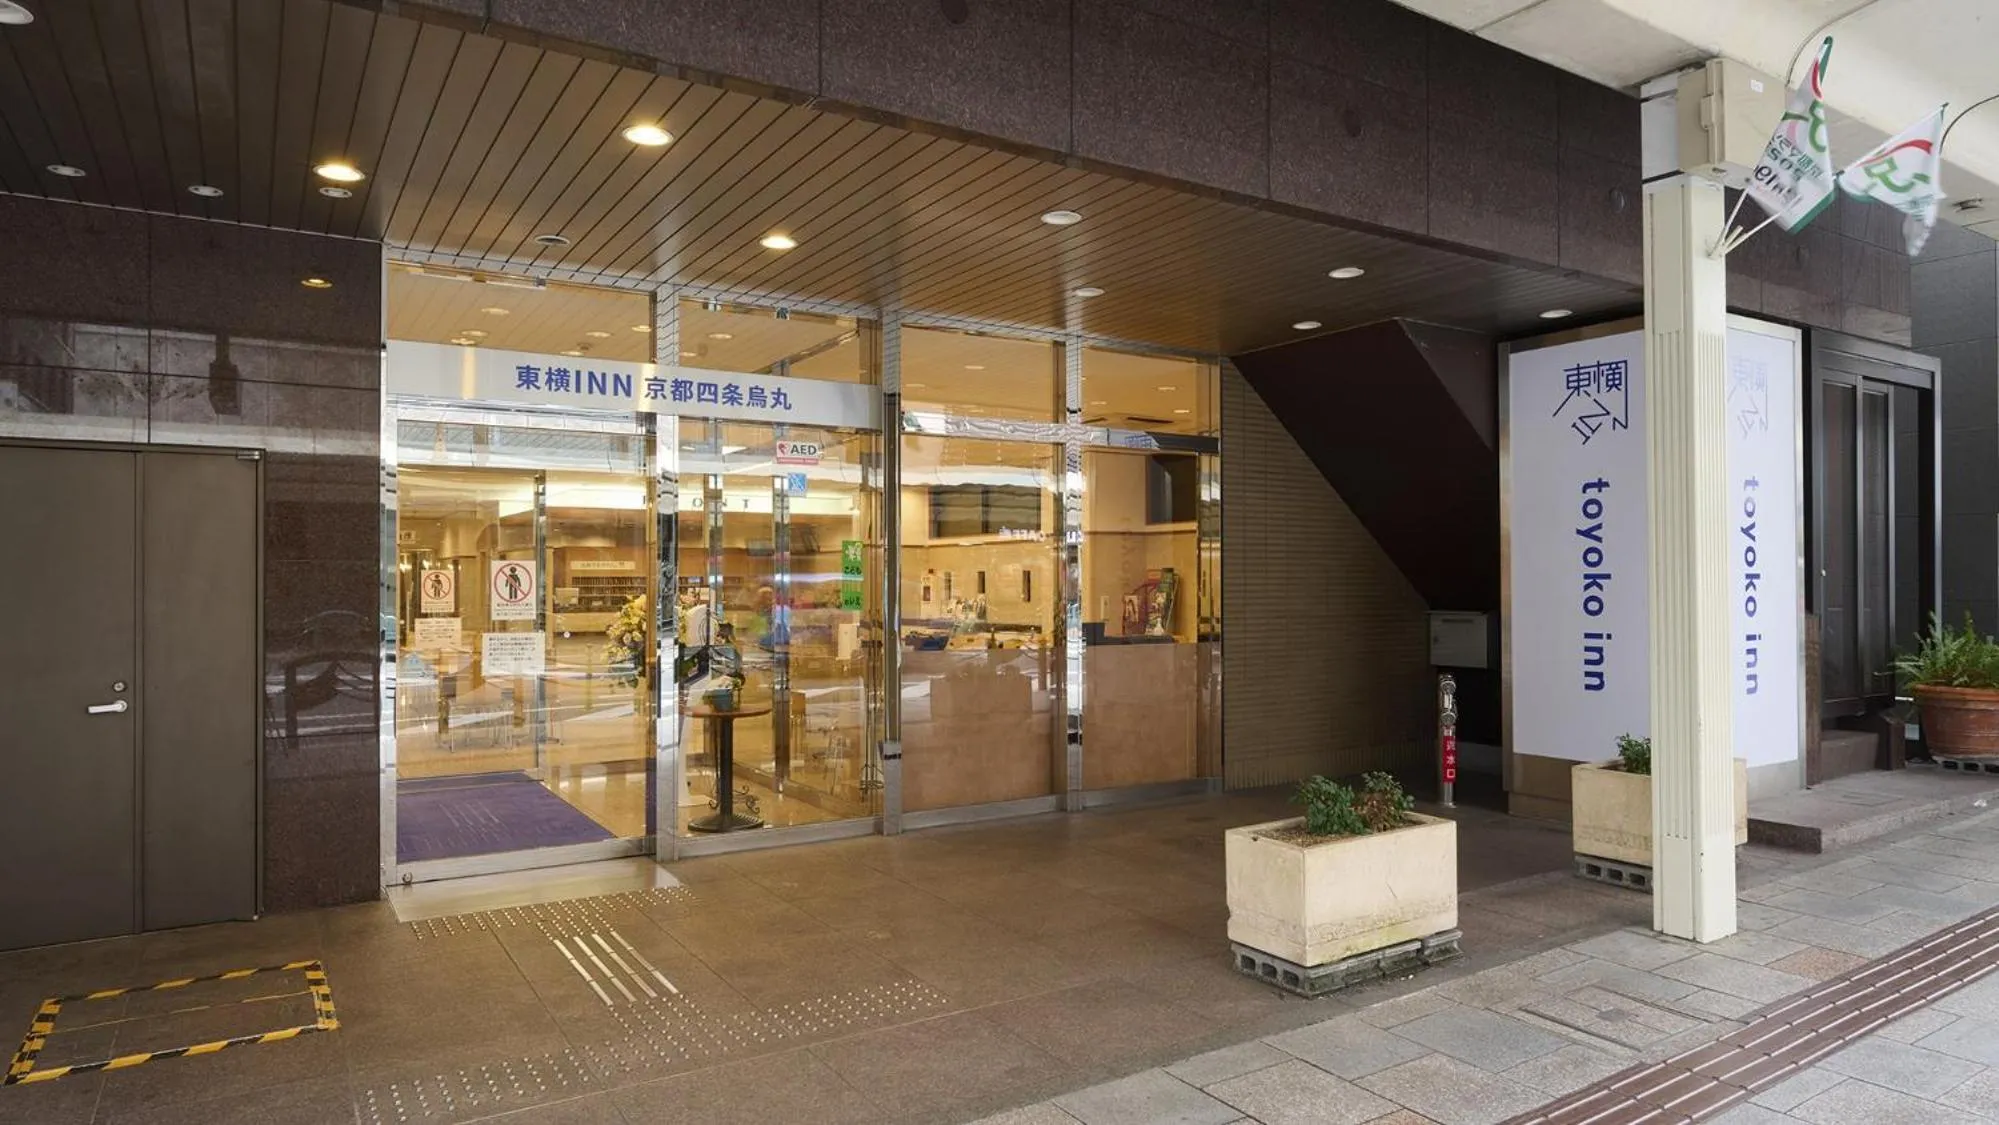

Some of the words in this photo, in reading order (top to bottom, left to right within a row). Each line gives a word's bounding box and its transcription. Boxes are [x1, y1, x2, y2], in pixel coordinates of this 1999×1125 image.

[515, 364, 632, 398] 東横INN
[644, 375, 792, 410] 京都四条烏丸
[790, 444, 817, 455] AED
[1576, 478, 1612, 616] toyoko
[1740, 476, 1761, 617] toyoko
[1584, 632, 1612, 691] inn
[1746, 634, 1762, 695] inn
